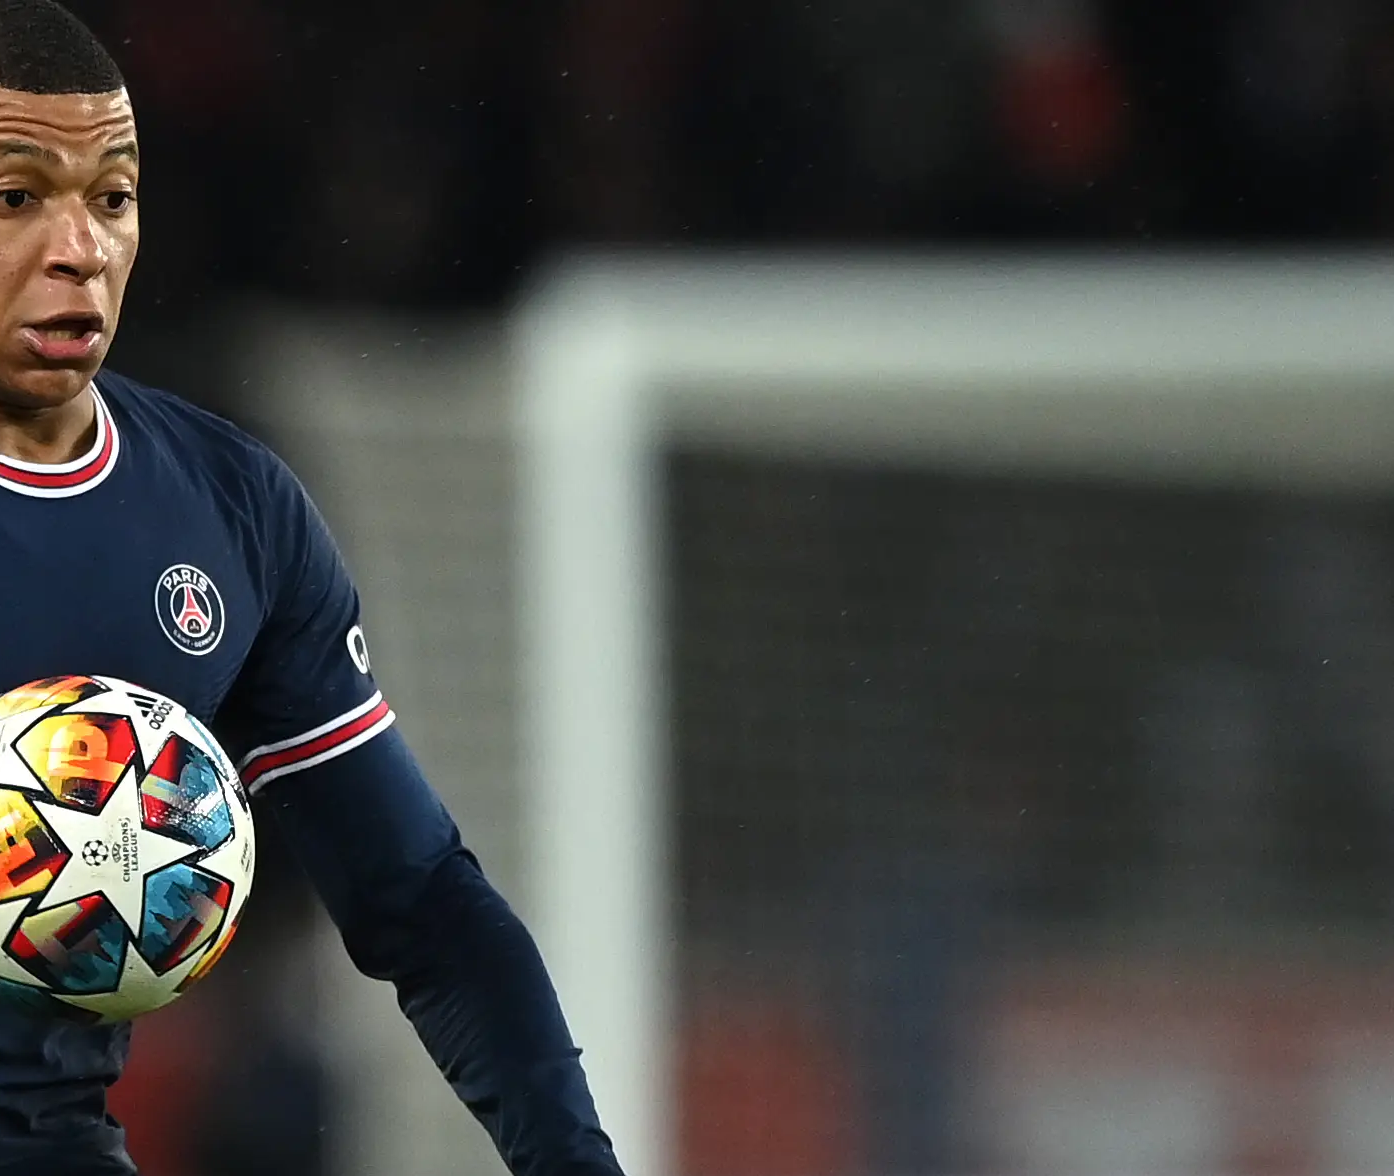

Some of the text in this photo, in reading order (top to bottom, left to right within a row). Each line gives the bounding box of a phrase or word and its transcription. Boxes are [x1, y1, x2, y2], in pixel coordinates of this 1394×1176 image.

[162, 568, 208, 592] PARIS
[149, 700, 174, 730] adidas
[121, 822, 131, 882] CHAMPIONS
[130, 832, 139, 871] LEAGUE
